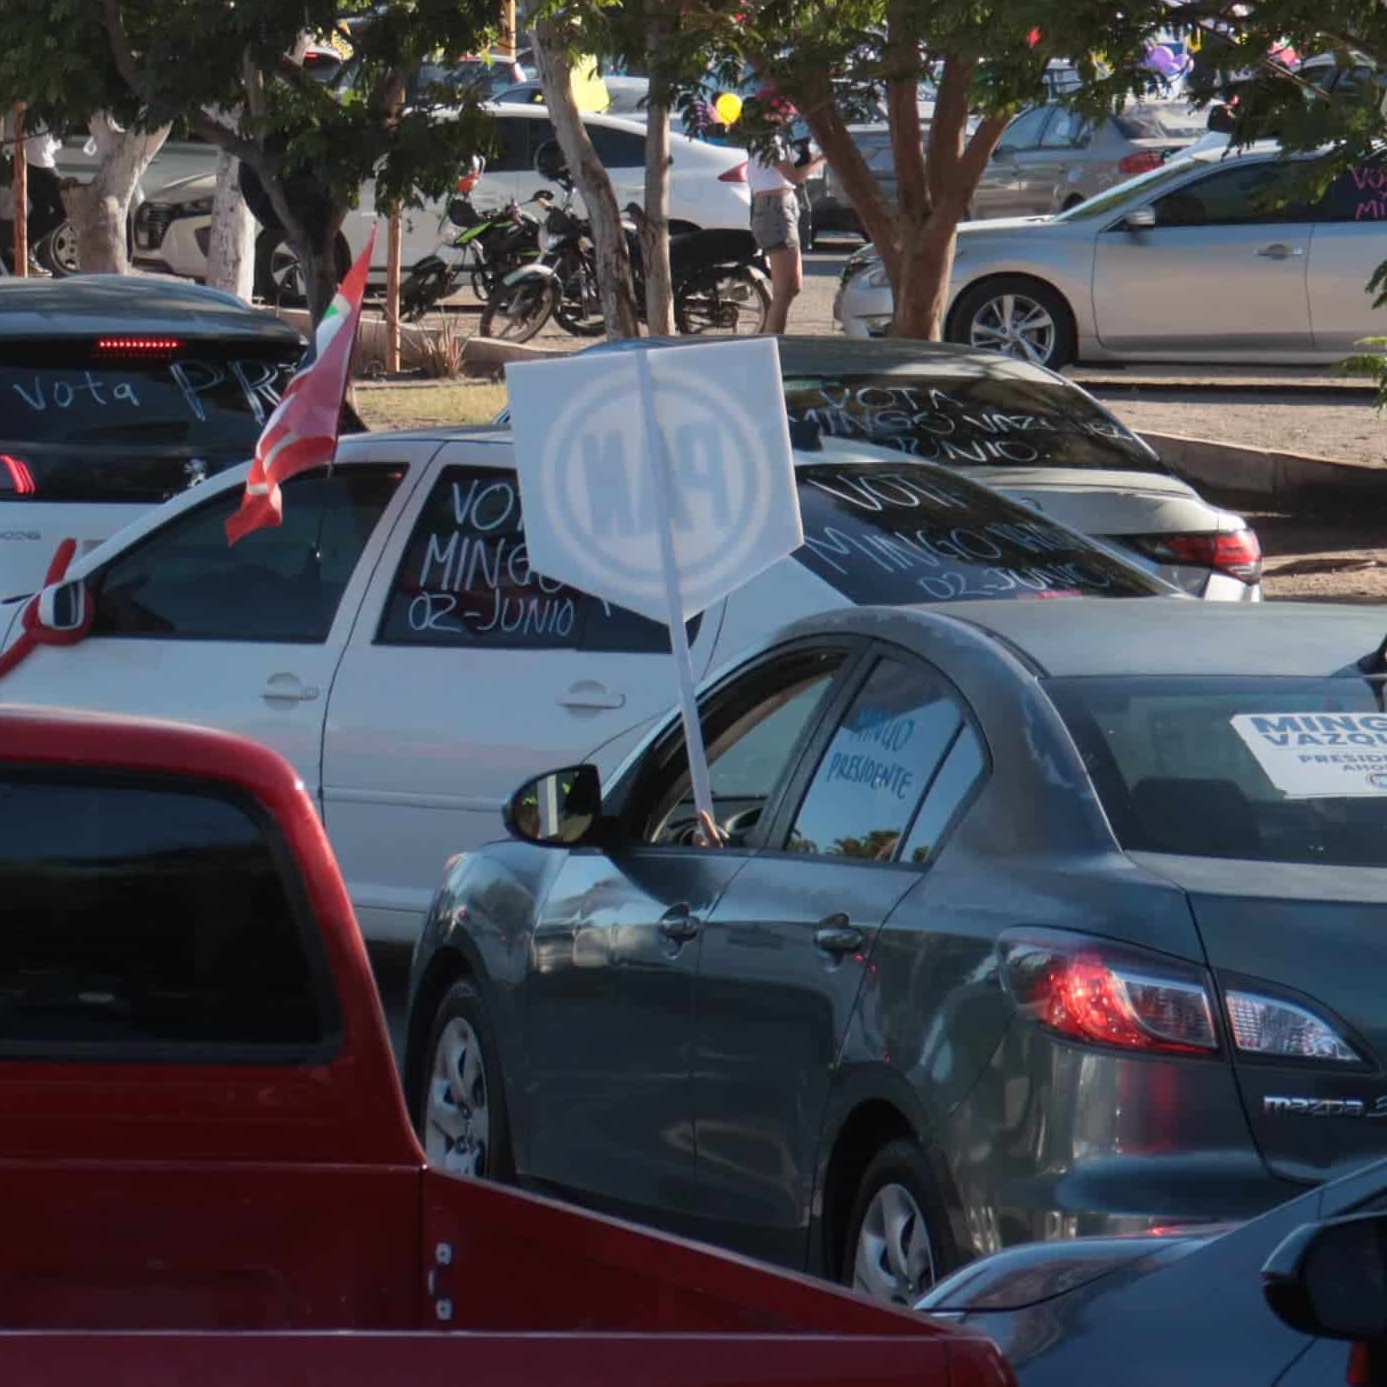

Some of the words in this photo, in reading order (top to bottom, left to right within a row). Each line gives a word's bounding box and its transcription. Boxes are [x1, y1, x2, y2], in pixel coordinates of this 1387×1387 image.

[819, 387, 964, 411] VOTA
[452, 469, 525, 531] VO
[1263, 1095, 1364, 1116] mazda
